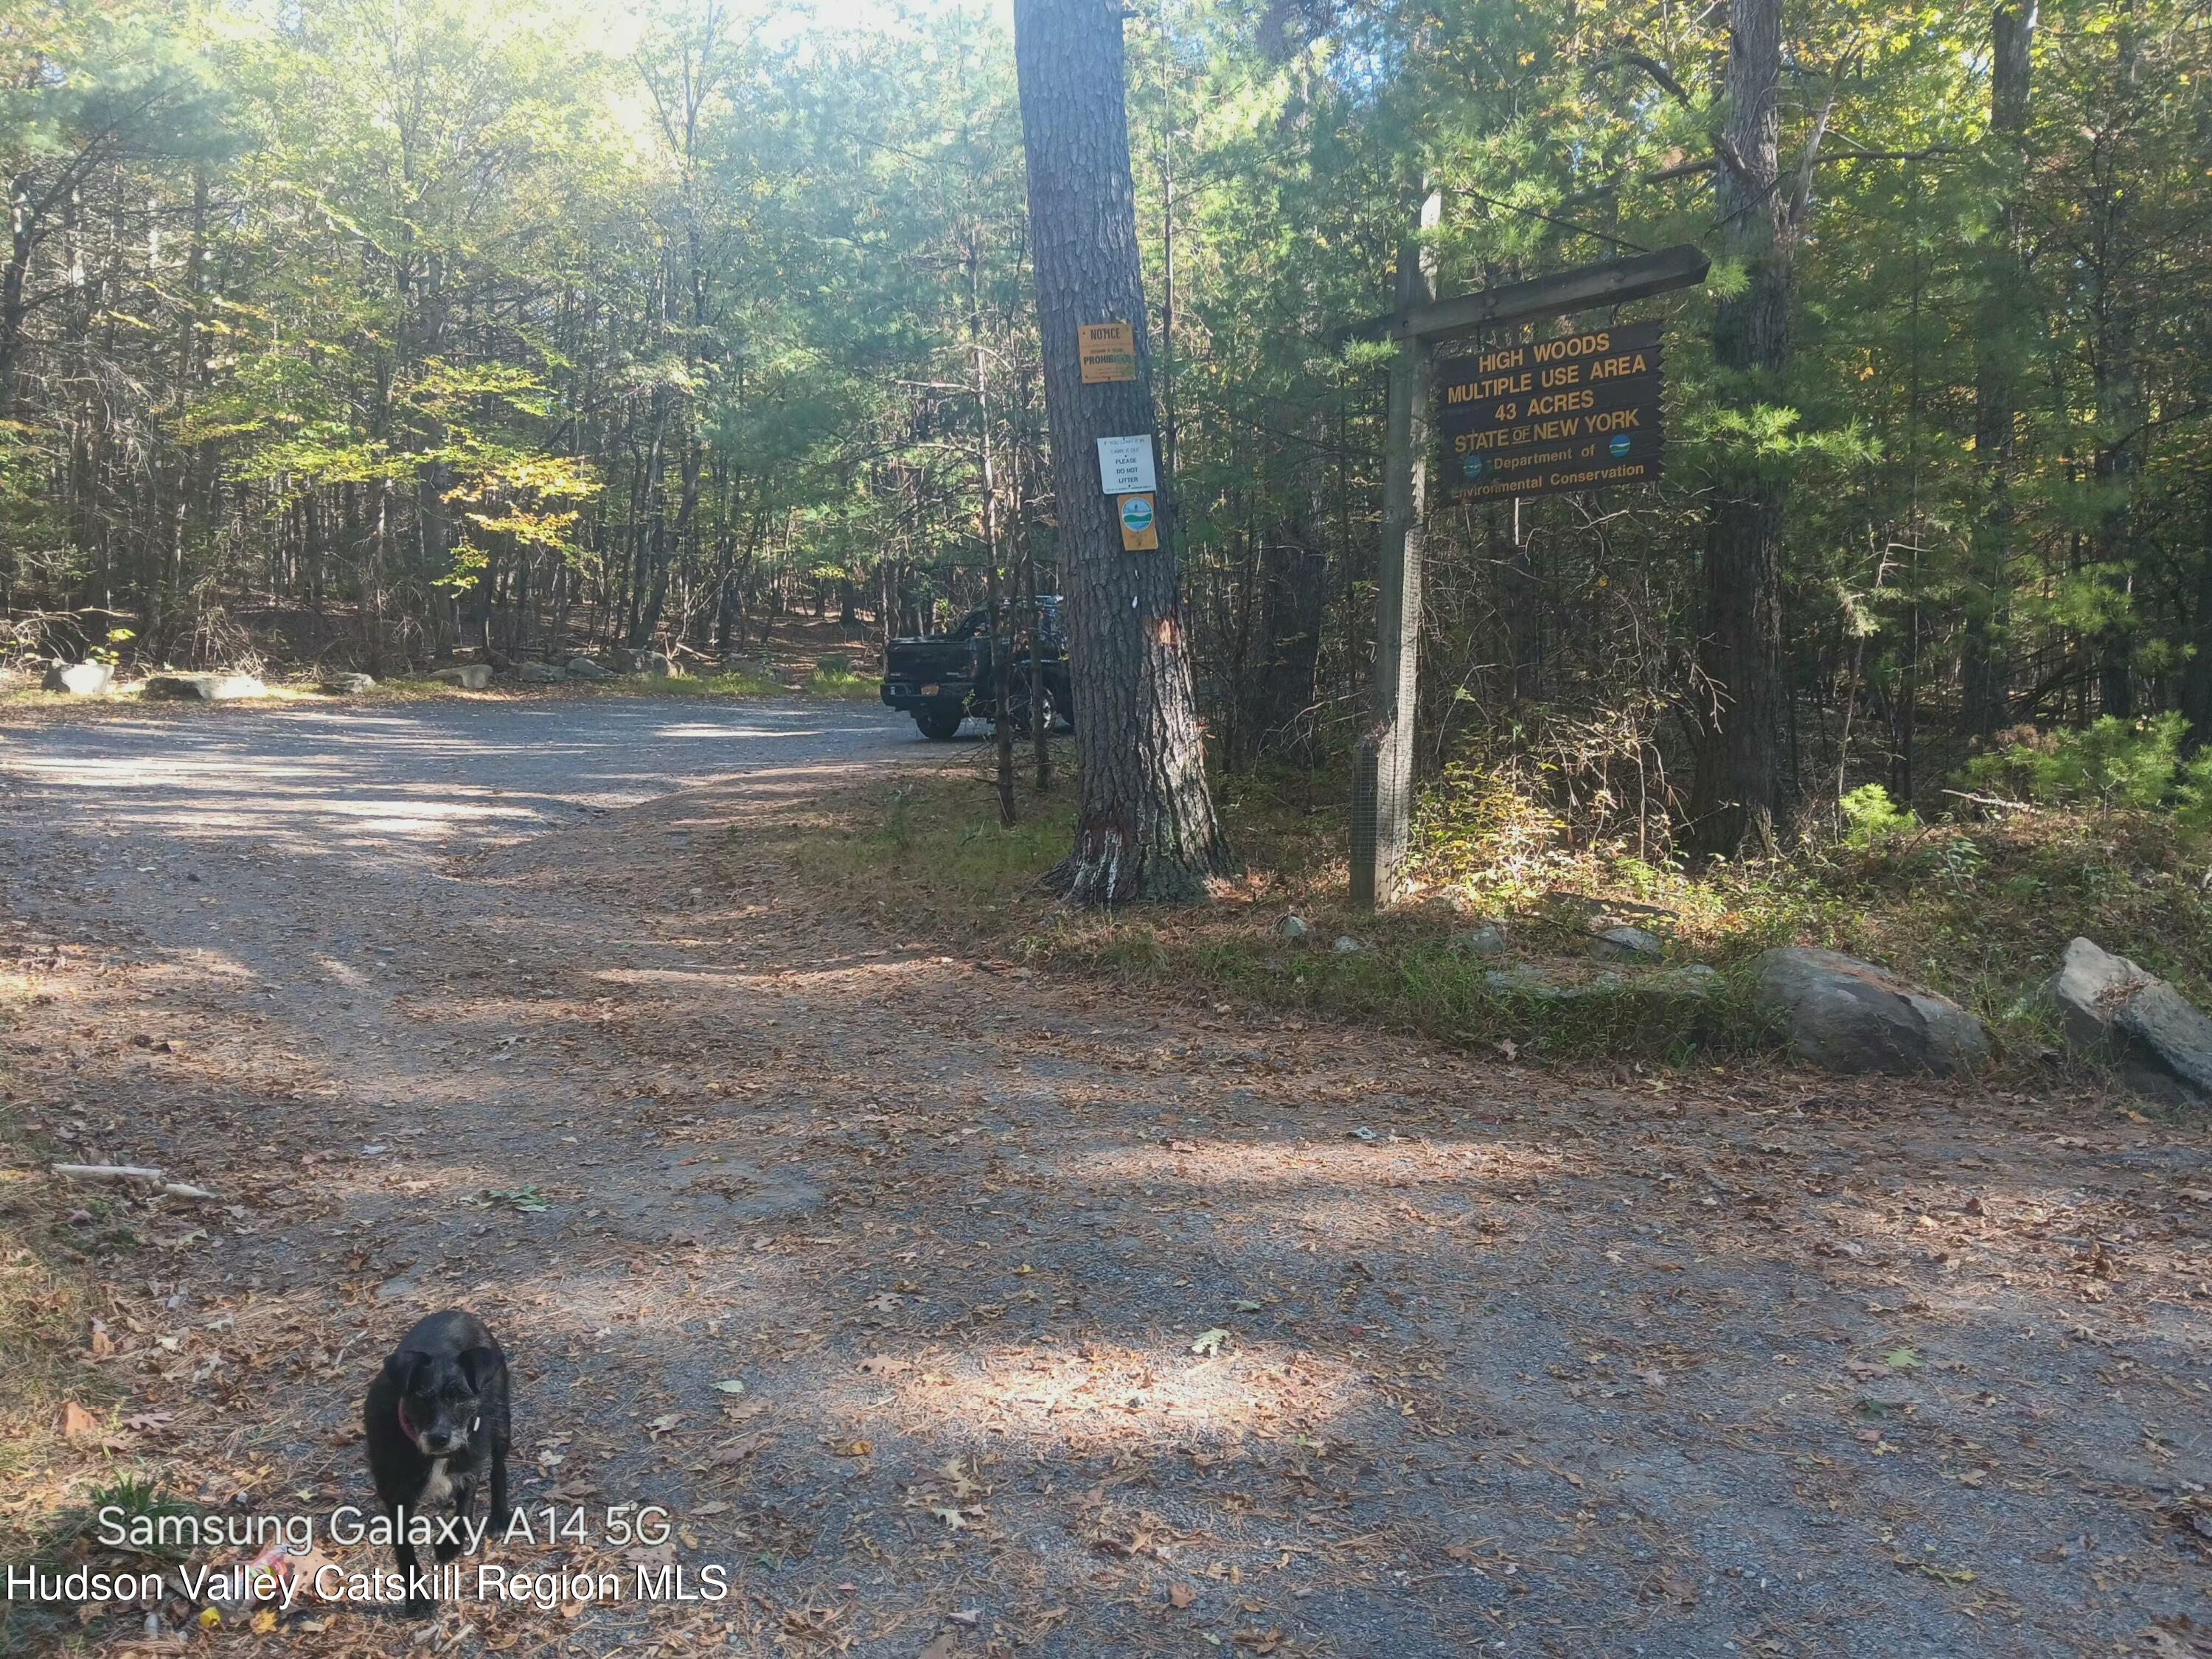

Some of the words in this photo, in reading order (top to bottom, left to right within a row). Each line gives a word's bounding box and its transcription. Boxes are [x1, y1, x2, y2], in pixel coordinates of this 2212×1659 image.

[1091, 327, 1120, 341] NOTICE
[1083, 354, 1131, 365] PROHIBD
[1479, 349, 1523, 373] HIGH
[1534, 333, 1610, 363] WOODS
[1448, 373, 1532, 404] MULTIPLE
[1542, 365, 1579, 388] USE
[1590, 354, 1646, 380] AREA
[1495, 403, 1517, 421] 43
[1527, 389, 1594, 417] ACRES
[1455, 428, 1509, 453] STATE
[1512, 426, 1531, 443] OF
[1534, 417, 1579, 441] NEW
[1585, 408, 1640, 433] YORK
[1493, 448, 1572, 471] Department
[1581, 443, 1596, 457] of
[1550, 463, 1644, 487] Conservation
